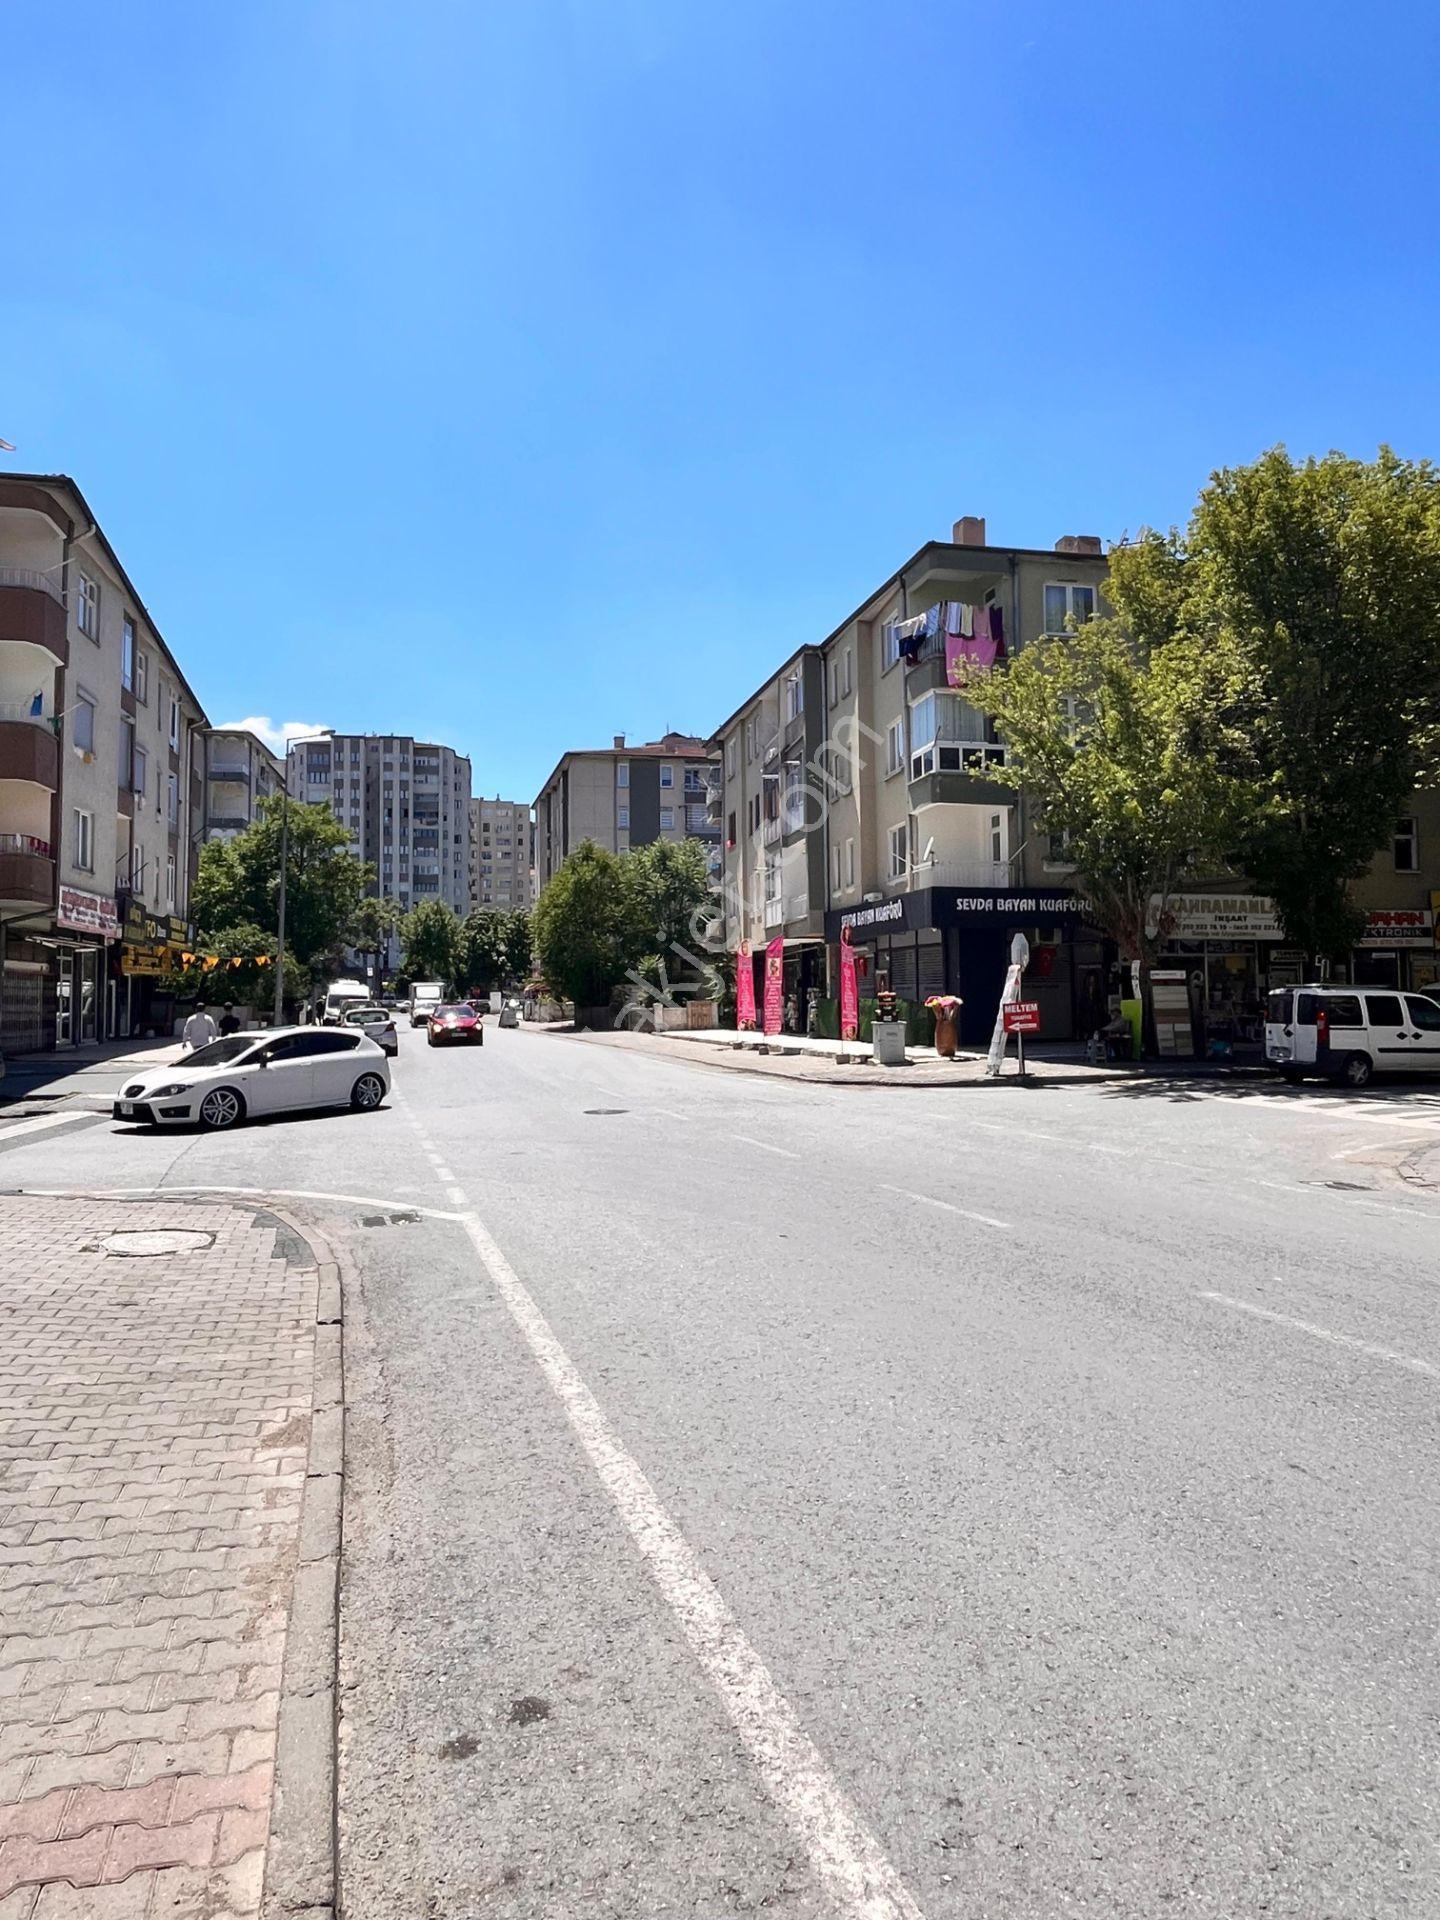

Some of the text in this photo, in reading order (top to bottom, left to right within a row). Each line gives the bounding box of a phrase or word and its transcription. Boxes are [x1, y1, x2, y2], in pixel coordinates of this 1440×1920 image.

[956, 898, 993, 911] SEVDA
[997, 898, 1036, 911] BAYAN
[1004, 1003, 1038, 1013] MELTEM
